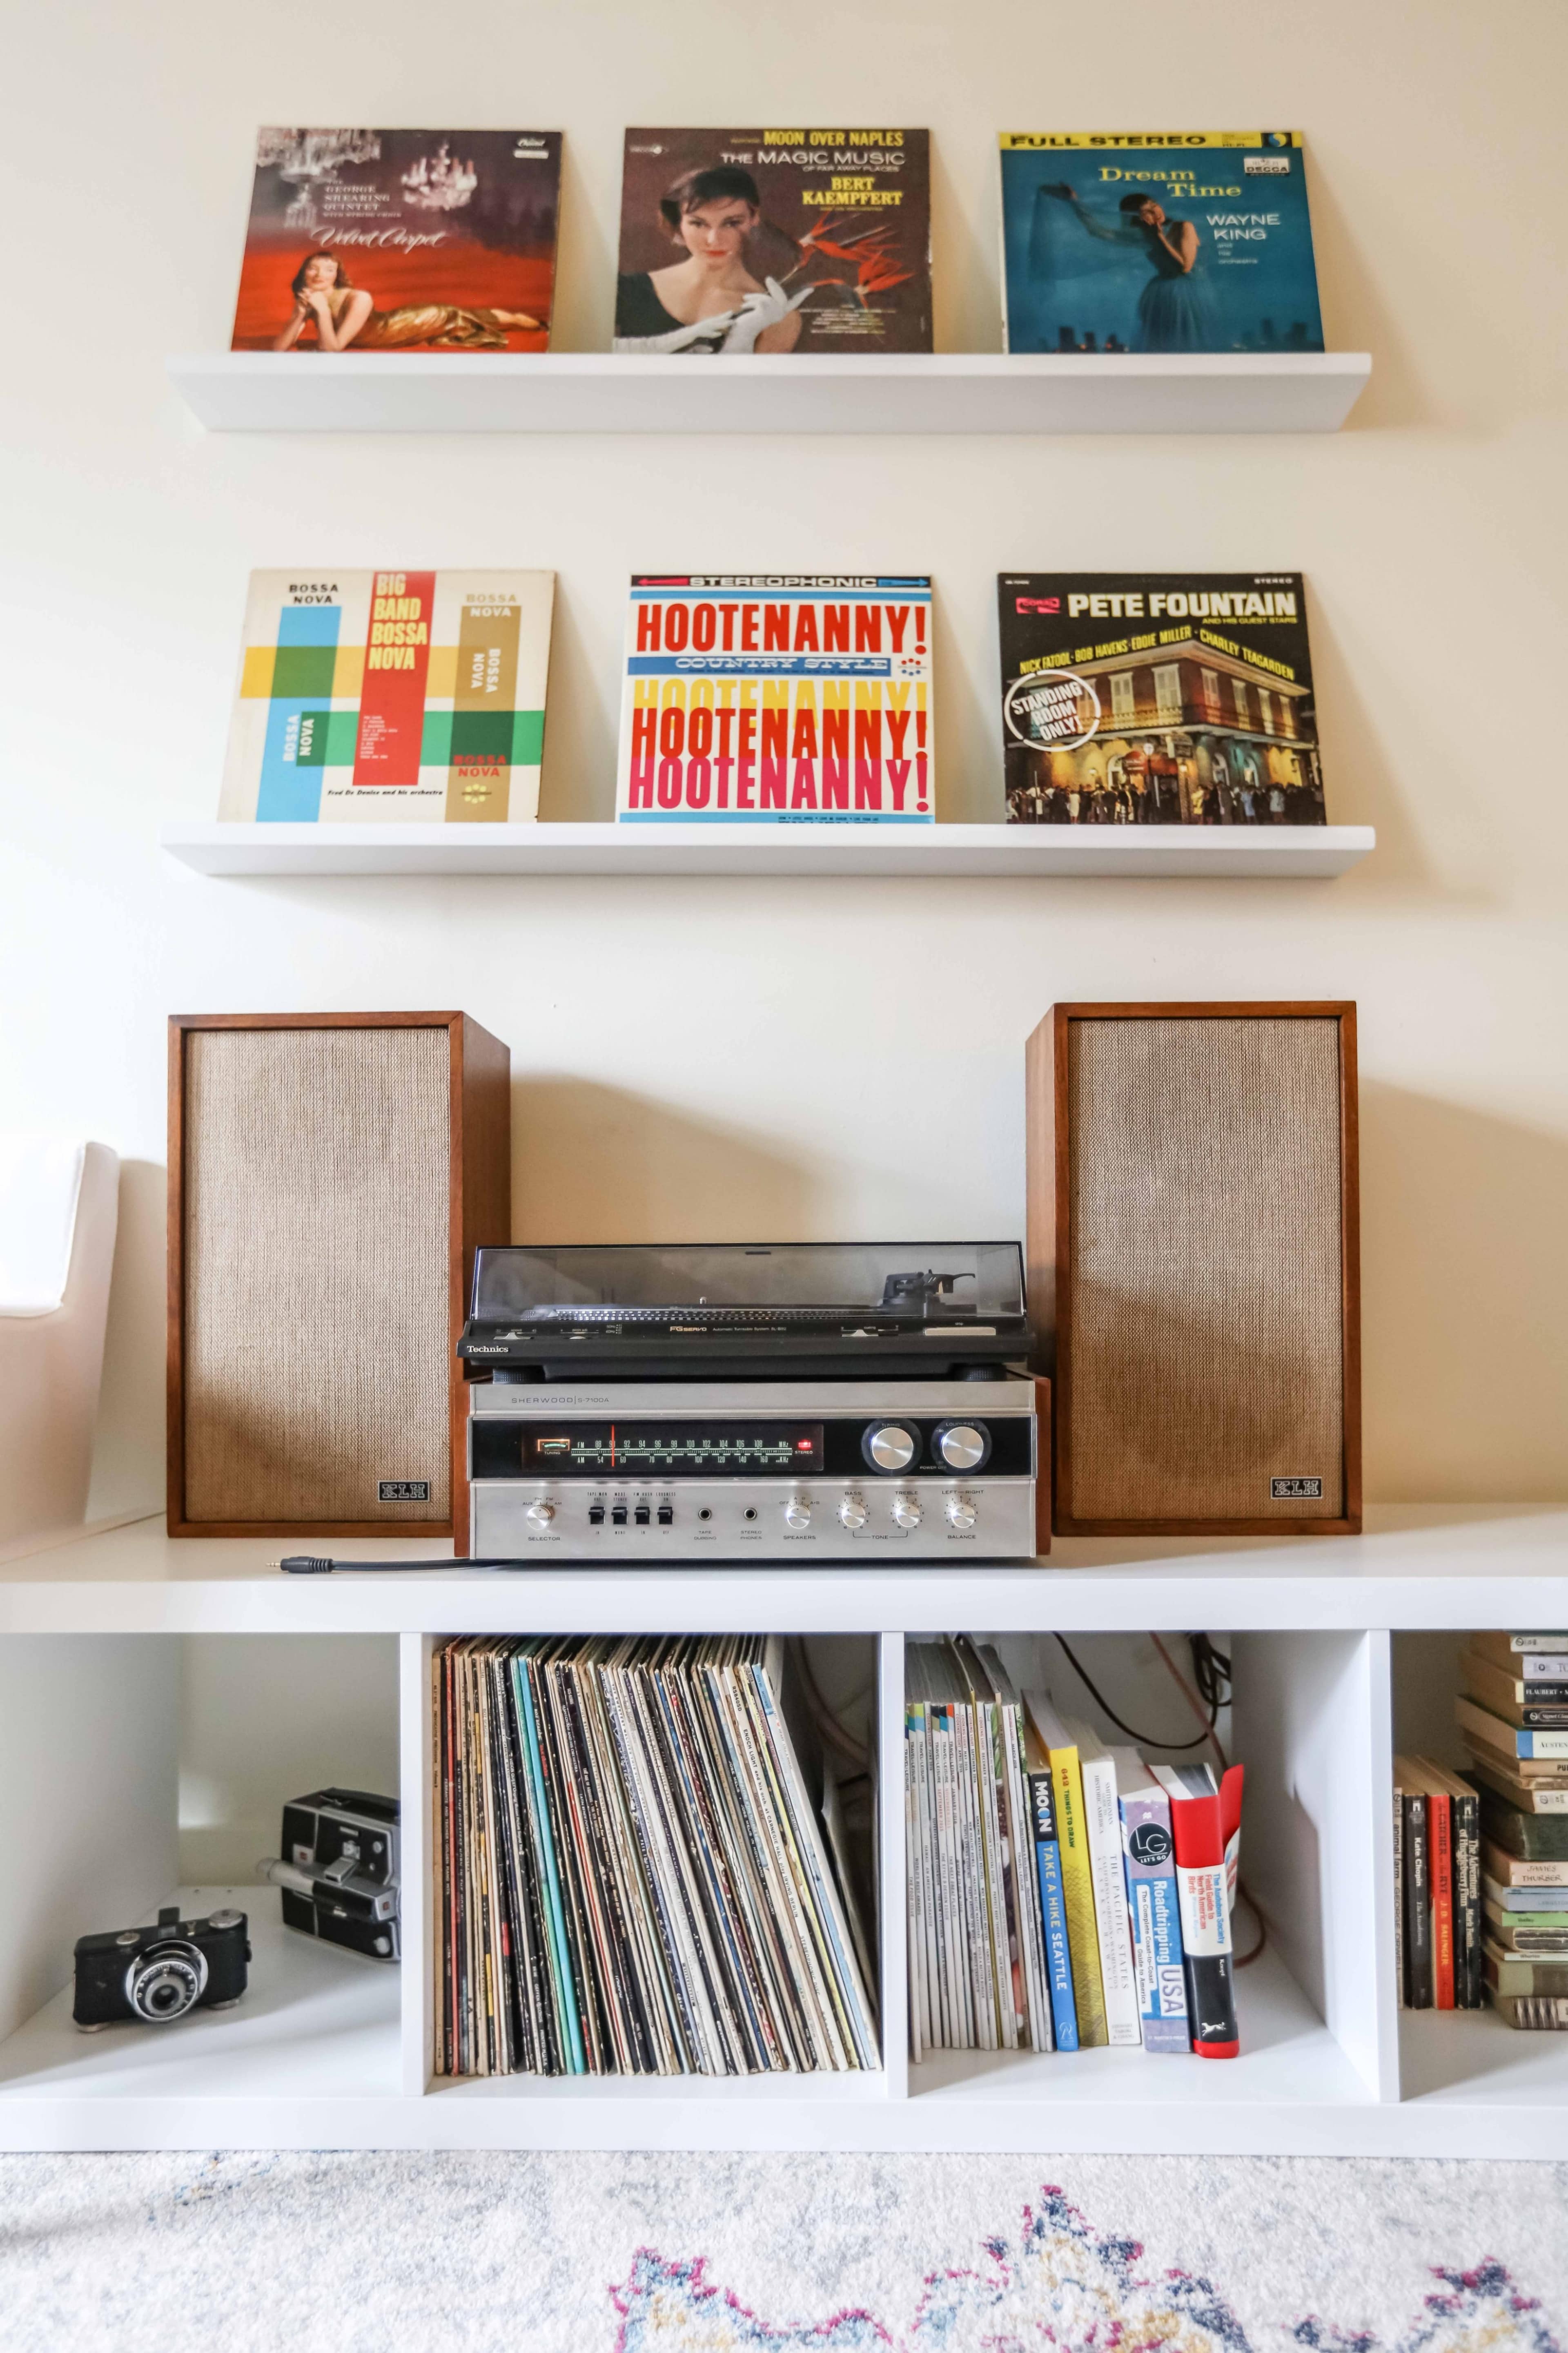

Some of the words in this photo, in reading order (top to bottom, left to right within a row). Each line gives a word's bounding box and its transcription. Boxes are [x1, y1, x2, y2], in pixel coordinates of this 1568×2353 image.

[764, 131, 804, 146] MOON
[809, 131, 845, 146] OVER
[849, 131, 904, 147] NAPLES
[1011, 135, 1080, 147] FULL
[1089, 135, 1207, 147] STEREO
[720, 153, 753, 164] THE
[757, 152, 829, 164] MAGIC
[834, 152, 906, 165] MUSIC
[831, 176, 875, 191] BERT
[1098, 167, 1196, 181] Dream
[802, 191, 903, 206] KAEMPFERT
[1167, 183, 1242, 198] Time
[1206, 213, 1281, 226] WAYNE
[311, 226, 380, 248] Velvet
[378, 227, 448, 255] Carpet
[1214, 228, 1267, 241] KING
[288, 584, 339, 593] BOSSA
[376, 573, 407, 596] BIG
[690, 576, 877, 588] STEREOPHONIC
[293, 595, 333, 604] NOVA
[373, 597, 421, 620] BAND
[466, 593, 517, 603] BOSSA
[1067, 593, 1144, 618] PETE
[1149, 593, 1297, 617] FOUNTAIN
[470, 607, 512, 617] NOVA
[371, 622, 428, 645] BOSSA
[637, 602, 927, 655] HOOTENANNY!
[368, 647, 416, 670] NOVA
[675, 657, 798, 669] COUNTRY
[804, 658, 888, 670] STYLE
[1019, 659, 1042, 675] NICK
[1041, 651, 1072, 670] FATOOL
[1074, 646, 1094, 663] BOB
[1095, 639, 1129, 658] HAVENS
[1131, 633, 1157, 651] EDDIE
[1159, 624, 1192, 644] MILLER
[1199, 627, 1240, 657] CHARLEY
[1241, 646, 1295, 681] TEAGARDEN
[470, 653, 486, 689] NOVA
[486, 648, 501, 693] BOSSA
[1011, 681, 1083, 716] STANDING
[1030, 700, 1077, 726] ROOM
[283, 715, 299, 762] BOSSA
[299, 718, 314, 756] NOVA
[631, 707, 928, 761] HOOTENANNY!
[1039, 715, 1084, 741] ONLY!
[453, 754, 506, 765] BOSSA
[458, 767, 501, 778] NOVA
[628, 757, 929, 812] HOOTENANNY!
[595, 1440, 601, 1448] 88
[624, 1440, 631, 1448] 92
[639, 1440, 646, 1448] 94
[654, 1440, 662, 1448] 96
[670, 1440, 678, 1448] 98
[686, 1440, 695, 1448] 100
[702, 1440, 711, 1448] 102
[719, 1440, 728, 1448] 104
[736, 1440, 744, 1448] 106
[754, 1440, 763, 1448] 108
[381, 1483, 425, 1499] KLH
[1274, 1480, 1319, 1496] KLH
[1061, 1769, 1069, 1786] 642
[1034, 1781, 1053, 1833] MOON
[1063, 1789, 1072, 1816] THINGS
[1105, 1781, 1114, 1826] SMITHSONIAN
[743, 1729, 752, 1750] ENOCH
[749, 1750, 757, 1768] LIGHT
[766, 1815, 779, 1844] CARNEGIE
[775, 1845, 784, 1861] HALL
[783, 1876, 793, 1896] IRVING
[789, 1897, 799, 1918] BERLIN
[1066, 1818, 1073, 1826] TO
[1067, 1827, 1076, 1848] DRAW
[1042, 1845, 1056, 1878] TAKE
[1110, 1854, 1118, 1878] THE
[1140, 1856, 1156, 1864] LET'S
[1047, 1883, 1056, 1893] A
[1187, 1876, 1196, 1894] Birds
[1048, 1898, 1061, 1929] HIKE
[1113, 1885, 1124, 1935] PACIFIC
[1142, 1902, 1150, 1934] Complete
[1153, 1880, 1170, 1963] Roadtripping
[1198, 1896, 1207, 1929] American
[1216, 1918, 1225, 1944] Society
[1051, 1932, 1068, 1991] SEATTLE
[1117, 1943, 1129, 1989] STATES
[1145, 1936, 1155, 1984] Coast-to-Coast
[1160, 1968, 1184, 2014] USA
